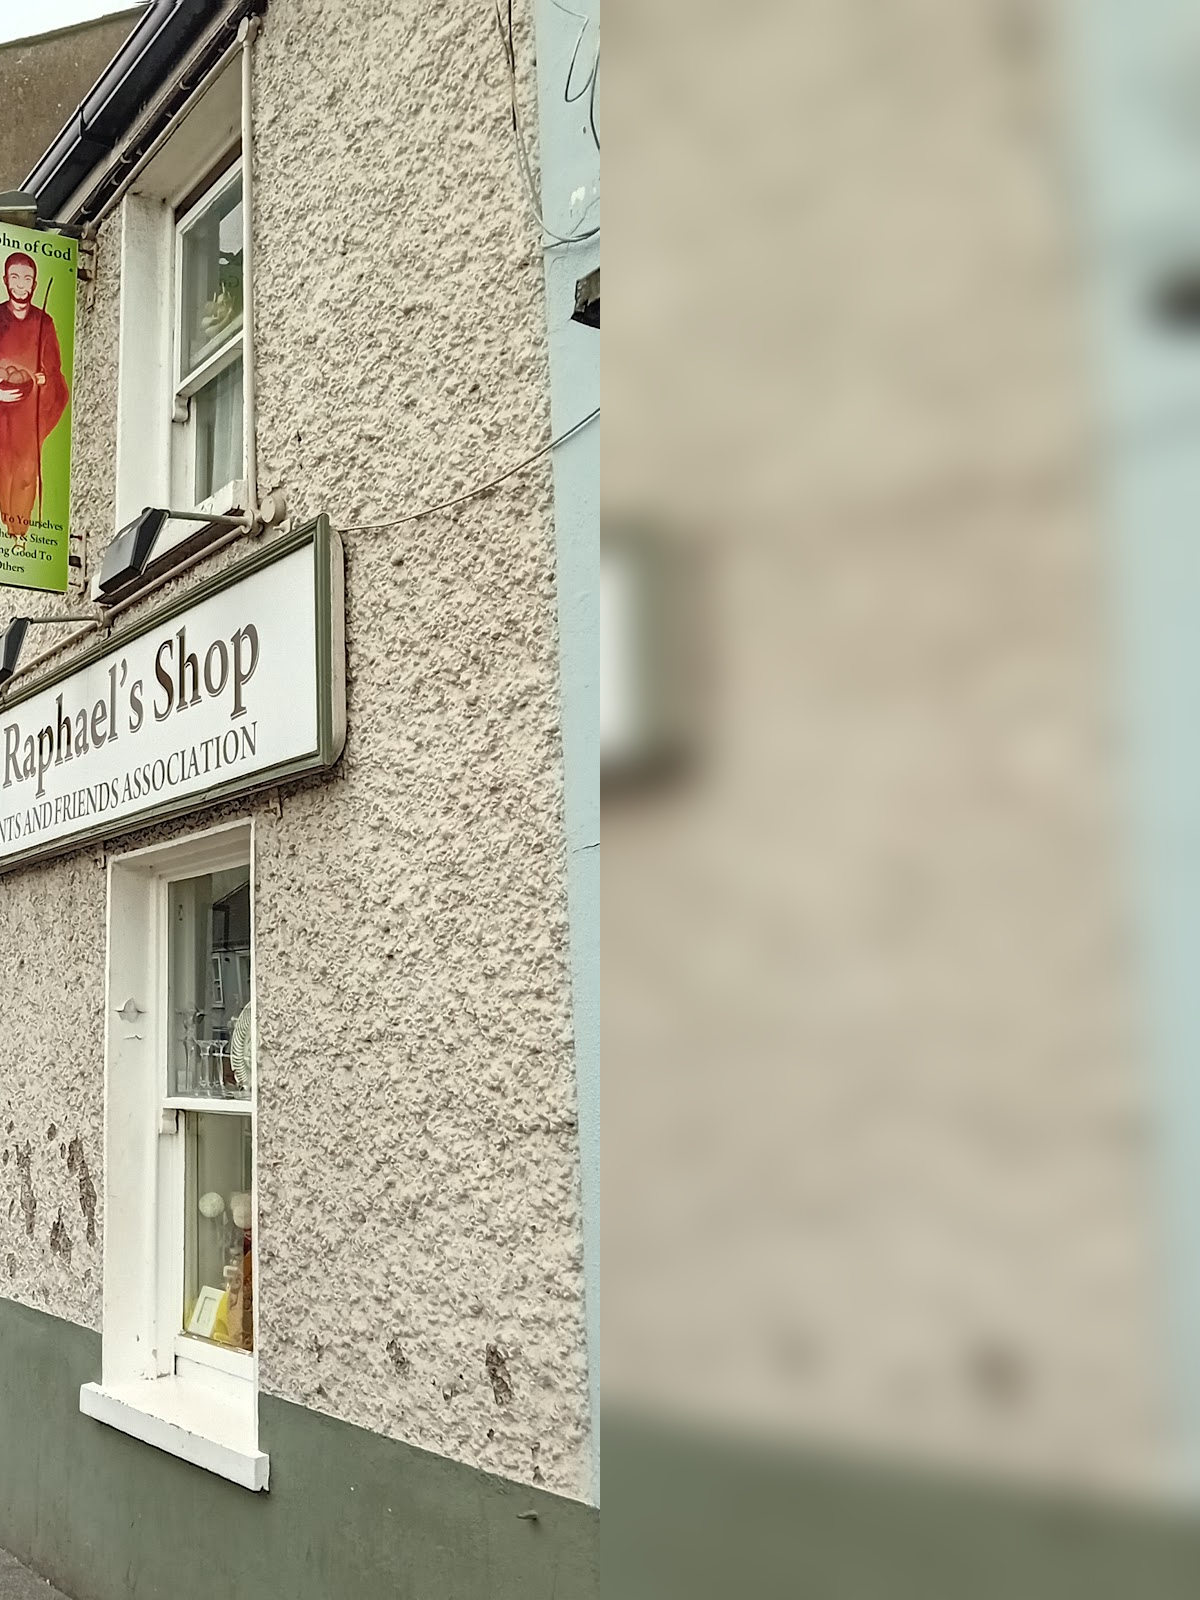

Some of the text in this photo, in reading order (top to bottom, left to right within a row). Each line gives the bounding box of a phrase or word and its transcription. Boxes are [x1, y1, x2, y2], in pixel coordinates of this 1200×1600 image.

[24, 240, 41, 253] of
[41, 243, 71, 261] God
[2, 513, 15, 523] To
[16, 514, 63, 531] Yourselves
[30, 533, 58, 546] Sisters
[11, 546, 37, 559] Good
[39, 551, 52, 561] To
[2, 657, 144, 800] Raphael's
[153, 623, 260, 721] Shop
[22, 801, 53, 837] AND
[54, 777, 119, 825] FRIENDS
[121, 721, 258, 803] ASSOCIATION
